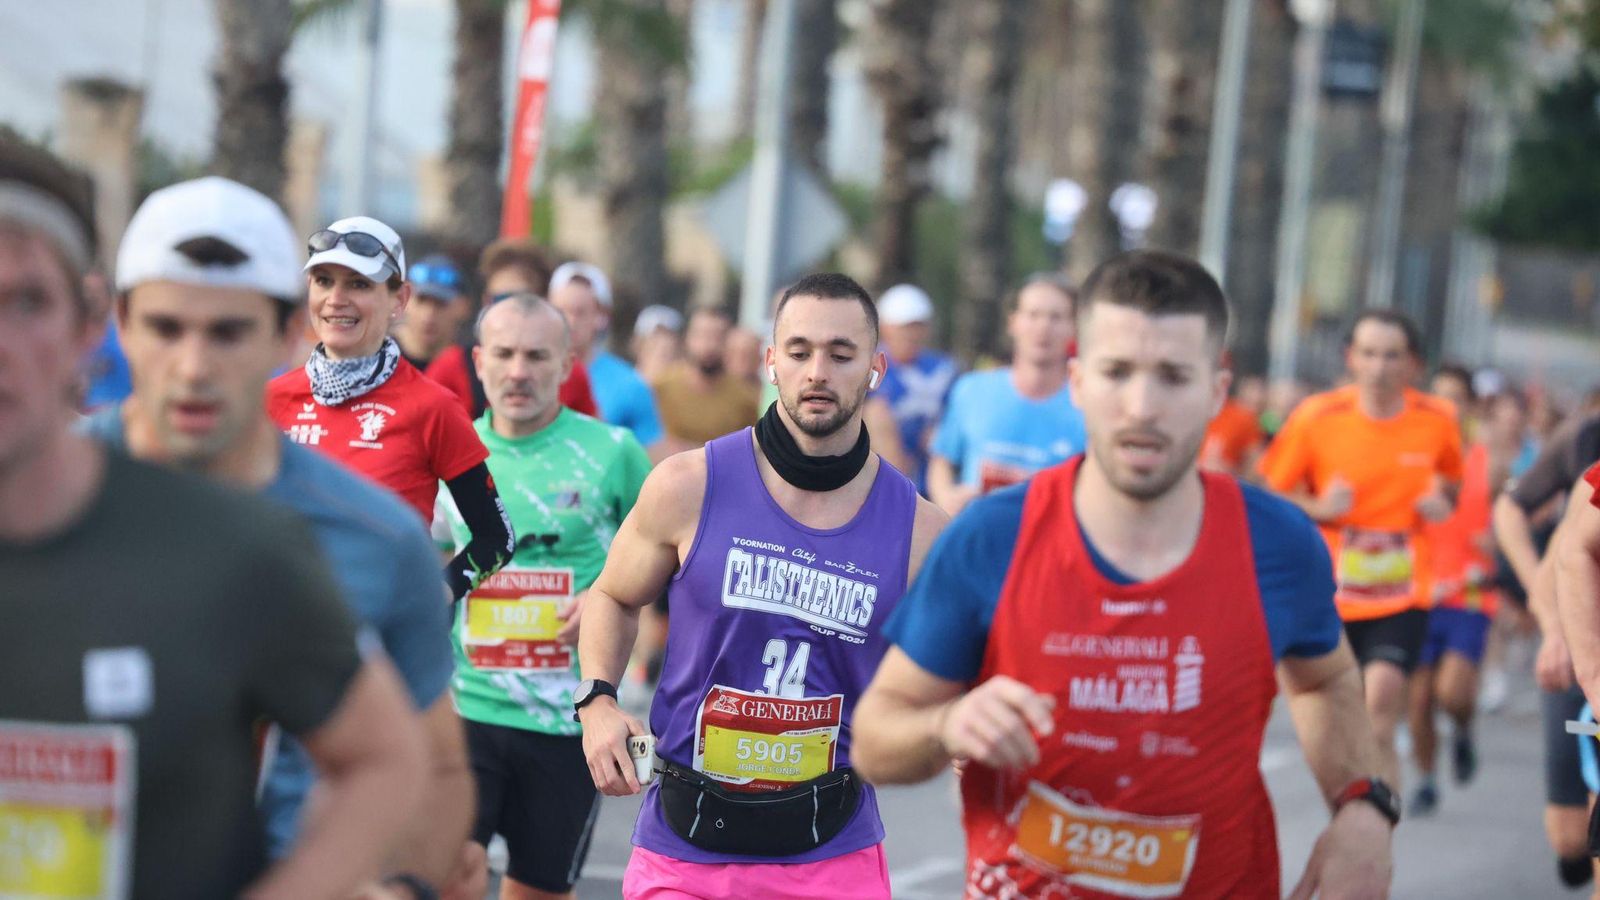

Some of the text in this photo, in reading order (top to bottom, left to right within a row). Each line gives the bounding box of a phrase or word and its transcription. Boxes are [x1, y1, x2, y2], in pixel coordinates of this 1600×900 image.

[739, 538, 786, 554] GORNATION
[721, 547, 878, 629] CALISTHENICS
[491, 604, 542, 625] 1807
[809, 624, 866, 645] CUP 2024
[754, 638, 811, 699] 34
[741, 699, 833, 722] GENERALI
[735, 737, 804, 765] 5905
[735, 763, 767, 775] JORGE
[1050, 813, 1161, 867] 12920
